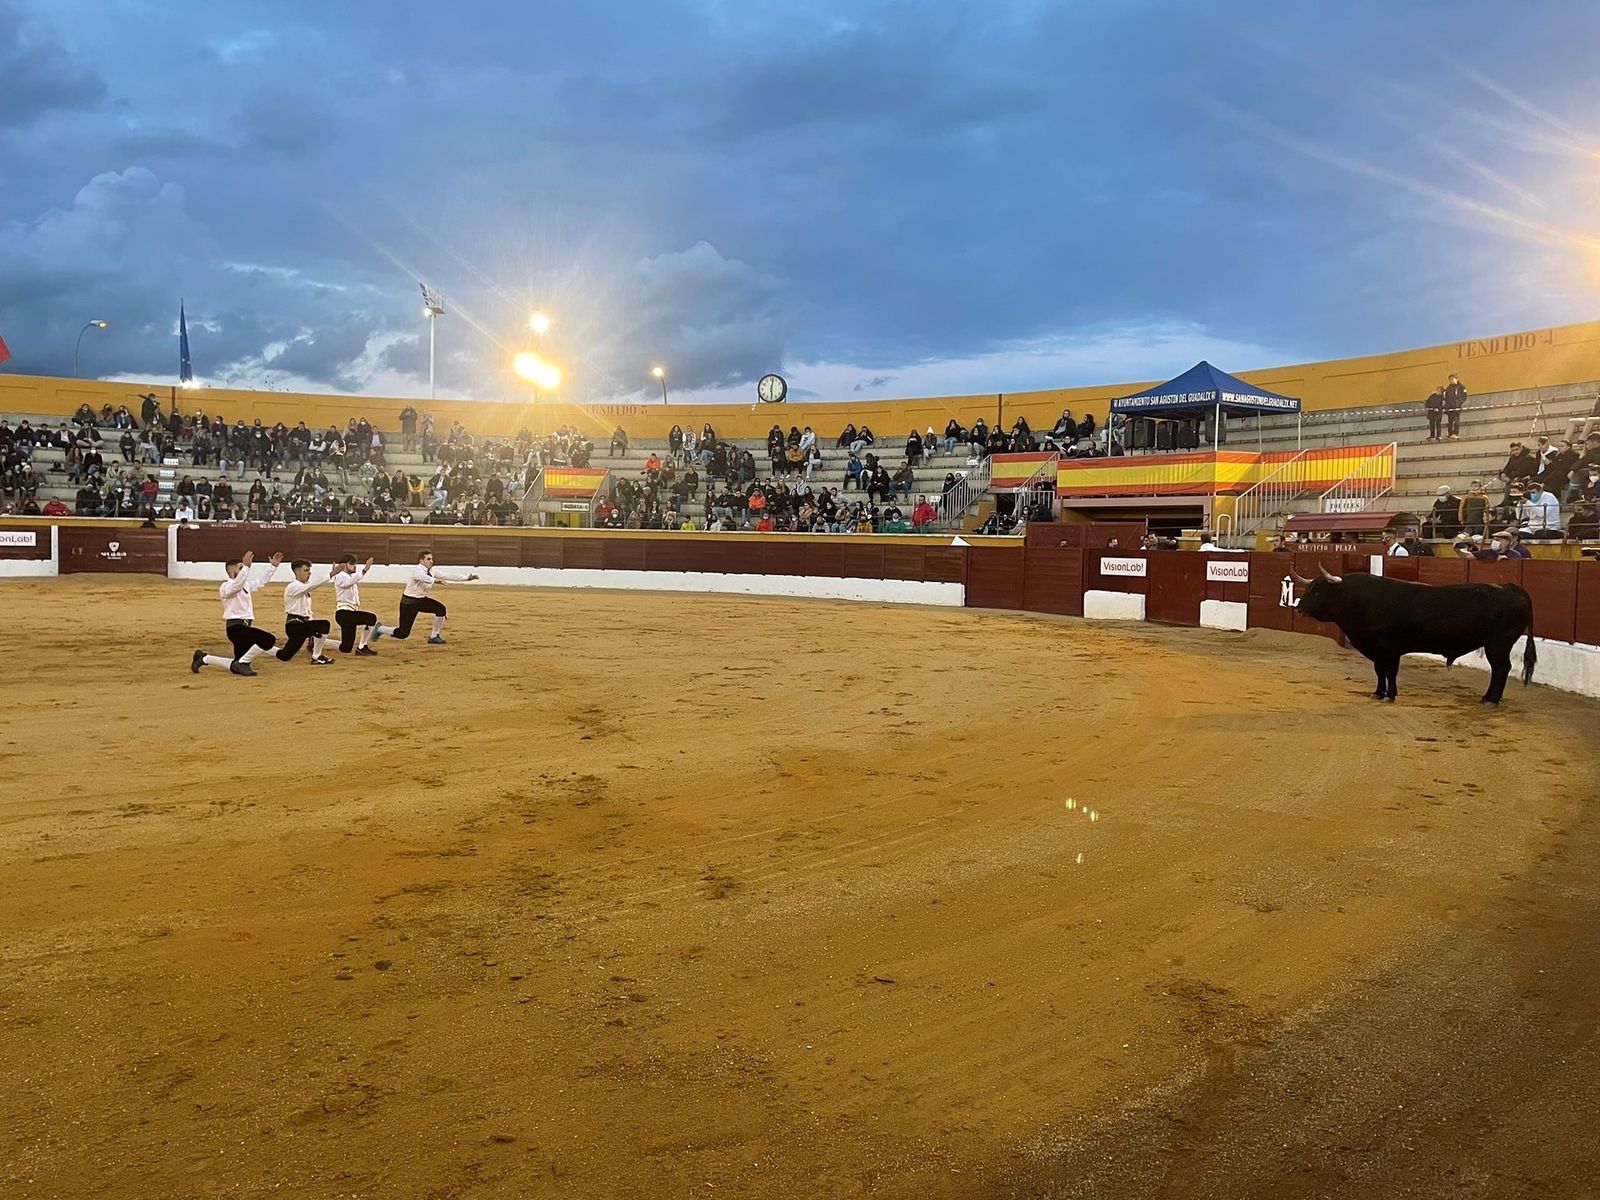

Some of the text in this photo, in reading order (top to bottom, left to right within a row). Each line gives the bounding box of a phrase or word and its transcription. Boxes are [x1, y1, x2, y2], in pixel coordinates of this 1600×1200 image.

[1455, 332, 1536, 358] TENDIDO
[1118, 397, 1150, 407] AYUNTAMIENTO
[1150, 396, 1160, 405] SAN
[1179, 393, 1188, 403] DEL
[1188, 391, 1211, 403] GUADALIX
[1335, 544, 1357, 552] PLAZA
[1103, 562, 1144, 572] VisionLab!
